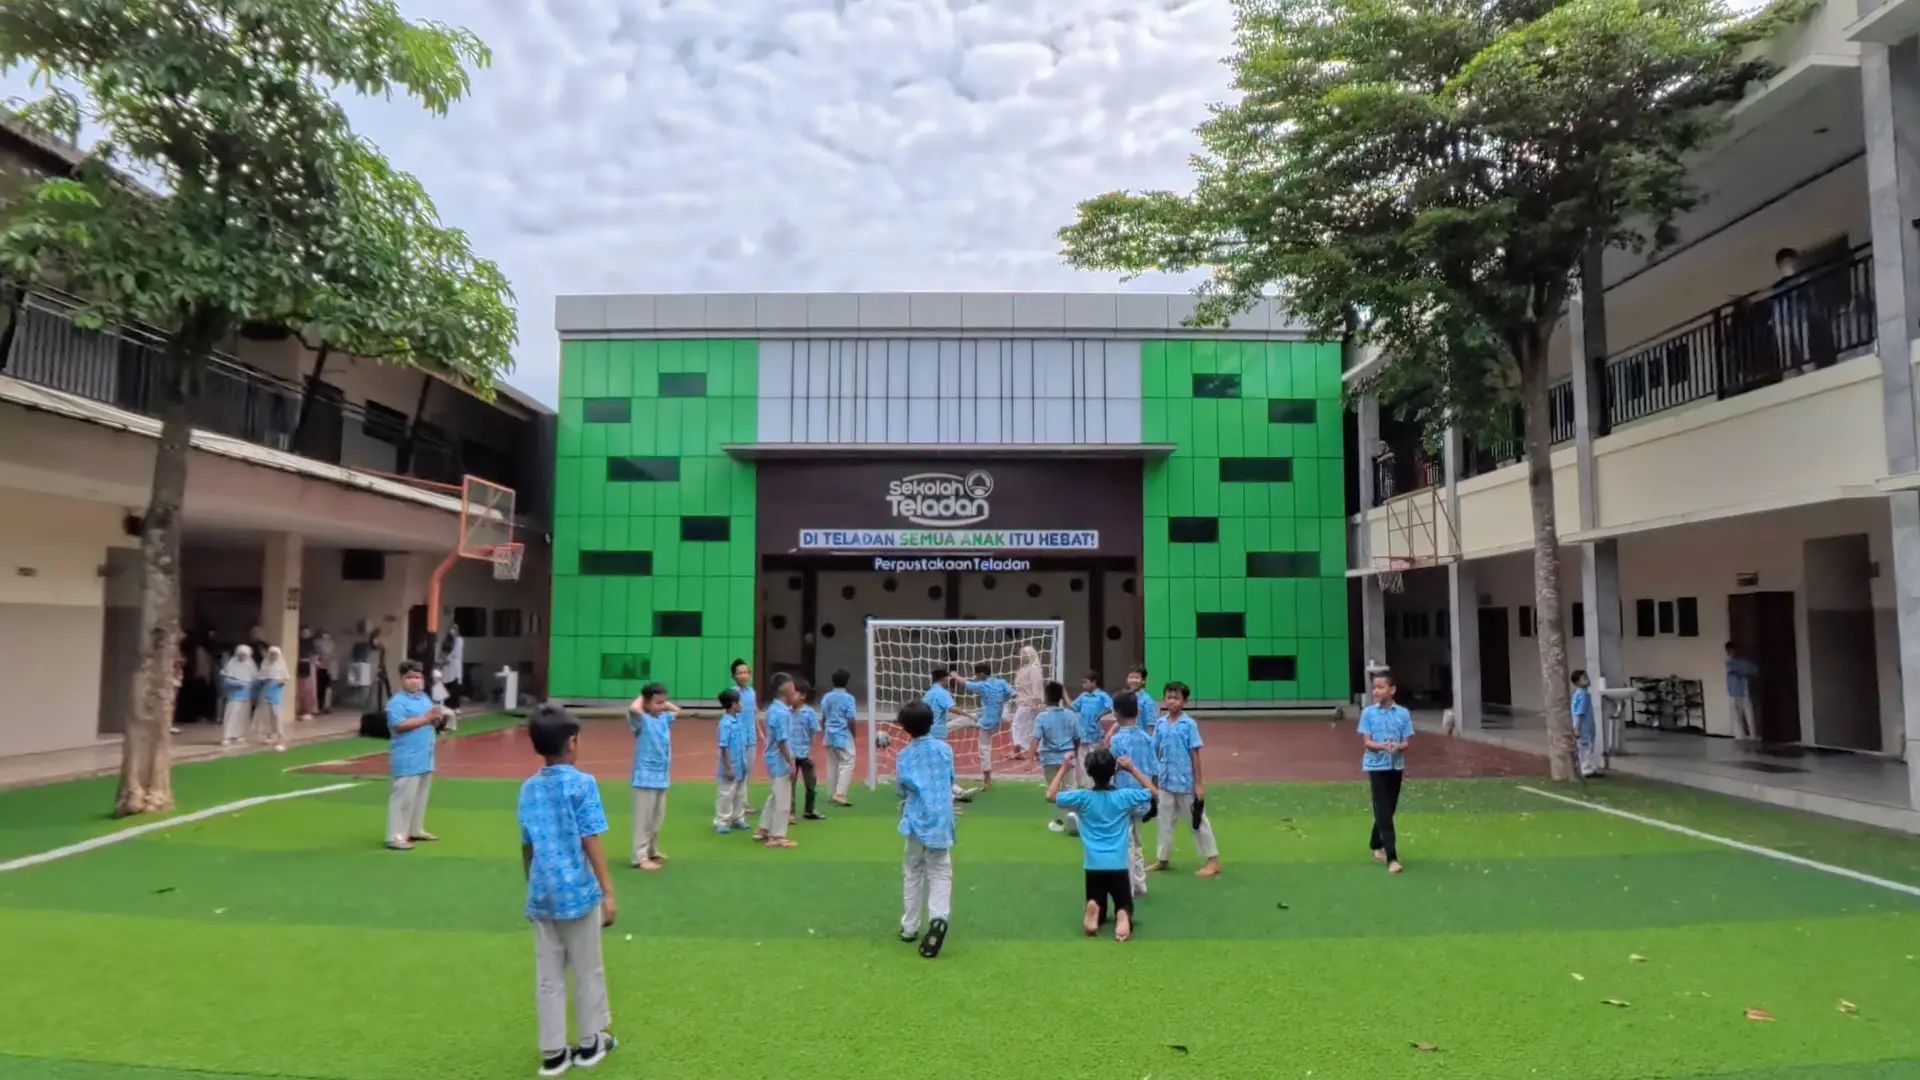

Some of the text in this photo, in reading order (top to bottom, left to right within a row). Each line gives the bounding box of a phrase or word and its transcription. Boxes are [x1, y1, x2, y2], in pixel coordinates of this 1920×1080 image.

[889, 480, 964, 496] Sekolah
[886, 495, 989, 517] Teladan
[803, 532, 1095, 546] DI TELADAN SEMUA ANAK ITU HEBAT!
[875, 557, 1030, 572] Perpustakaan Teladan
